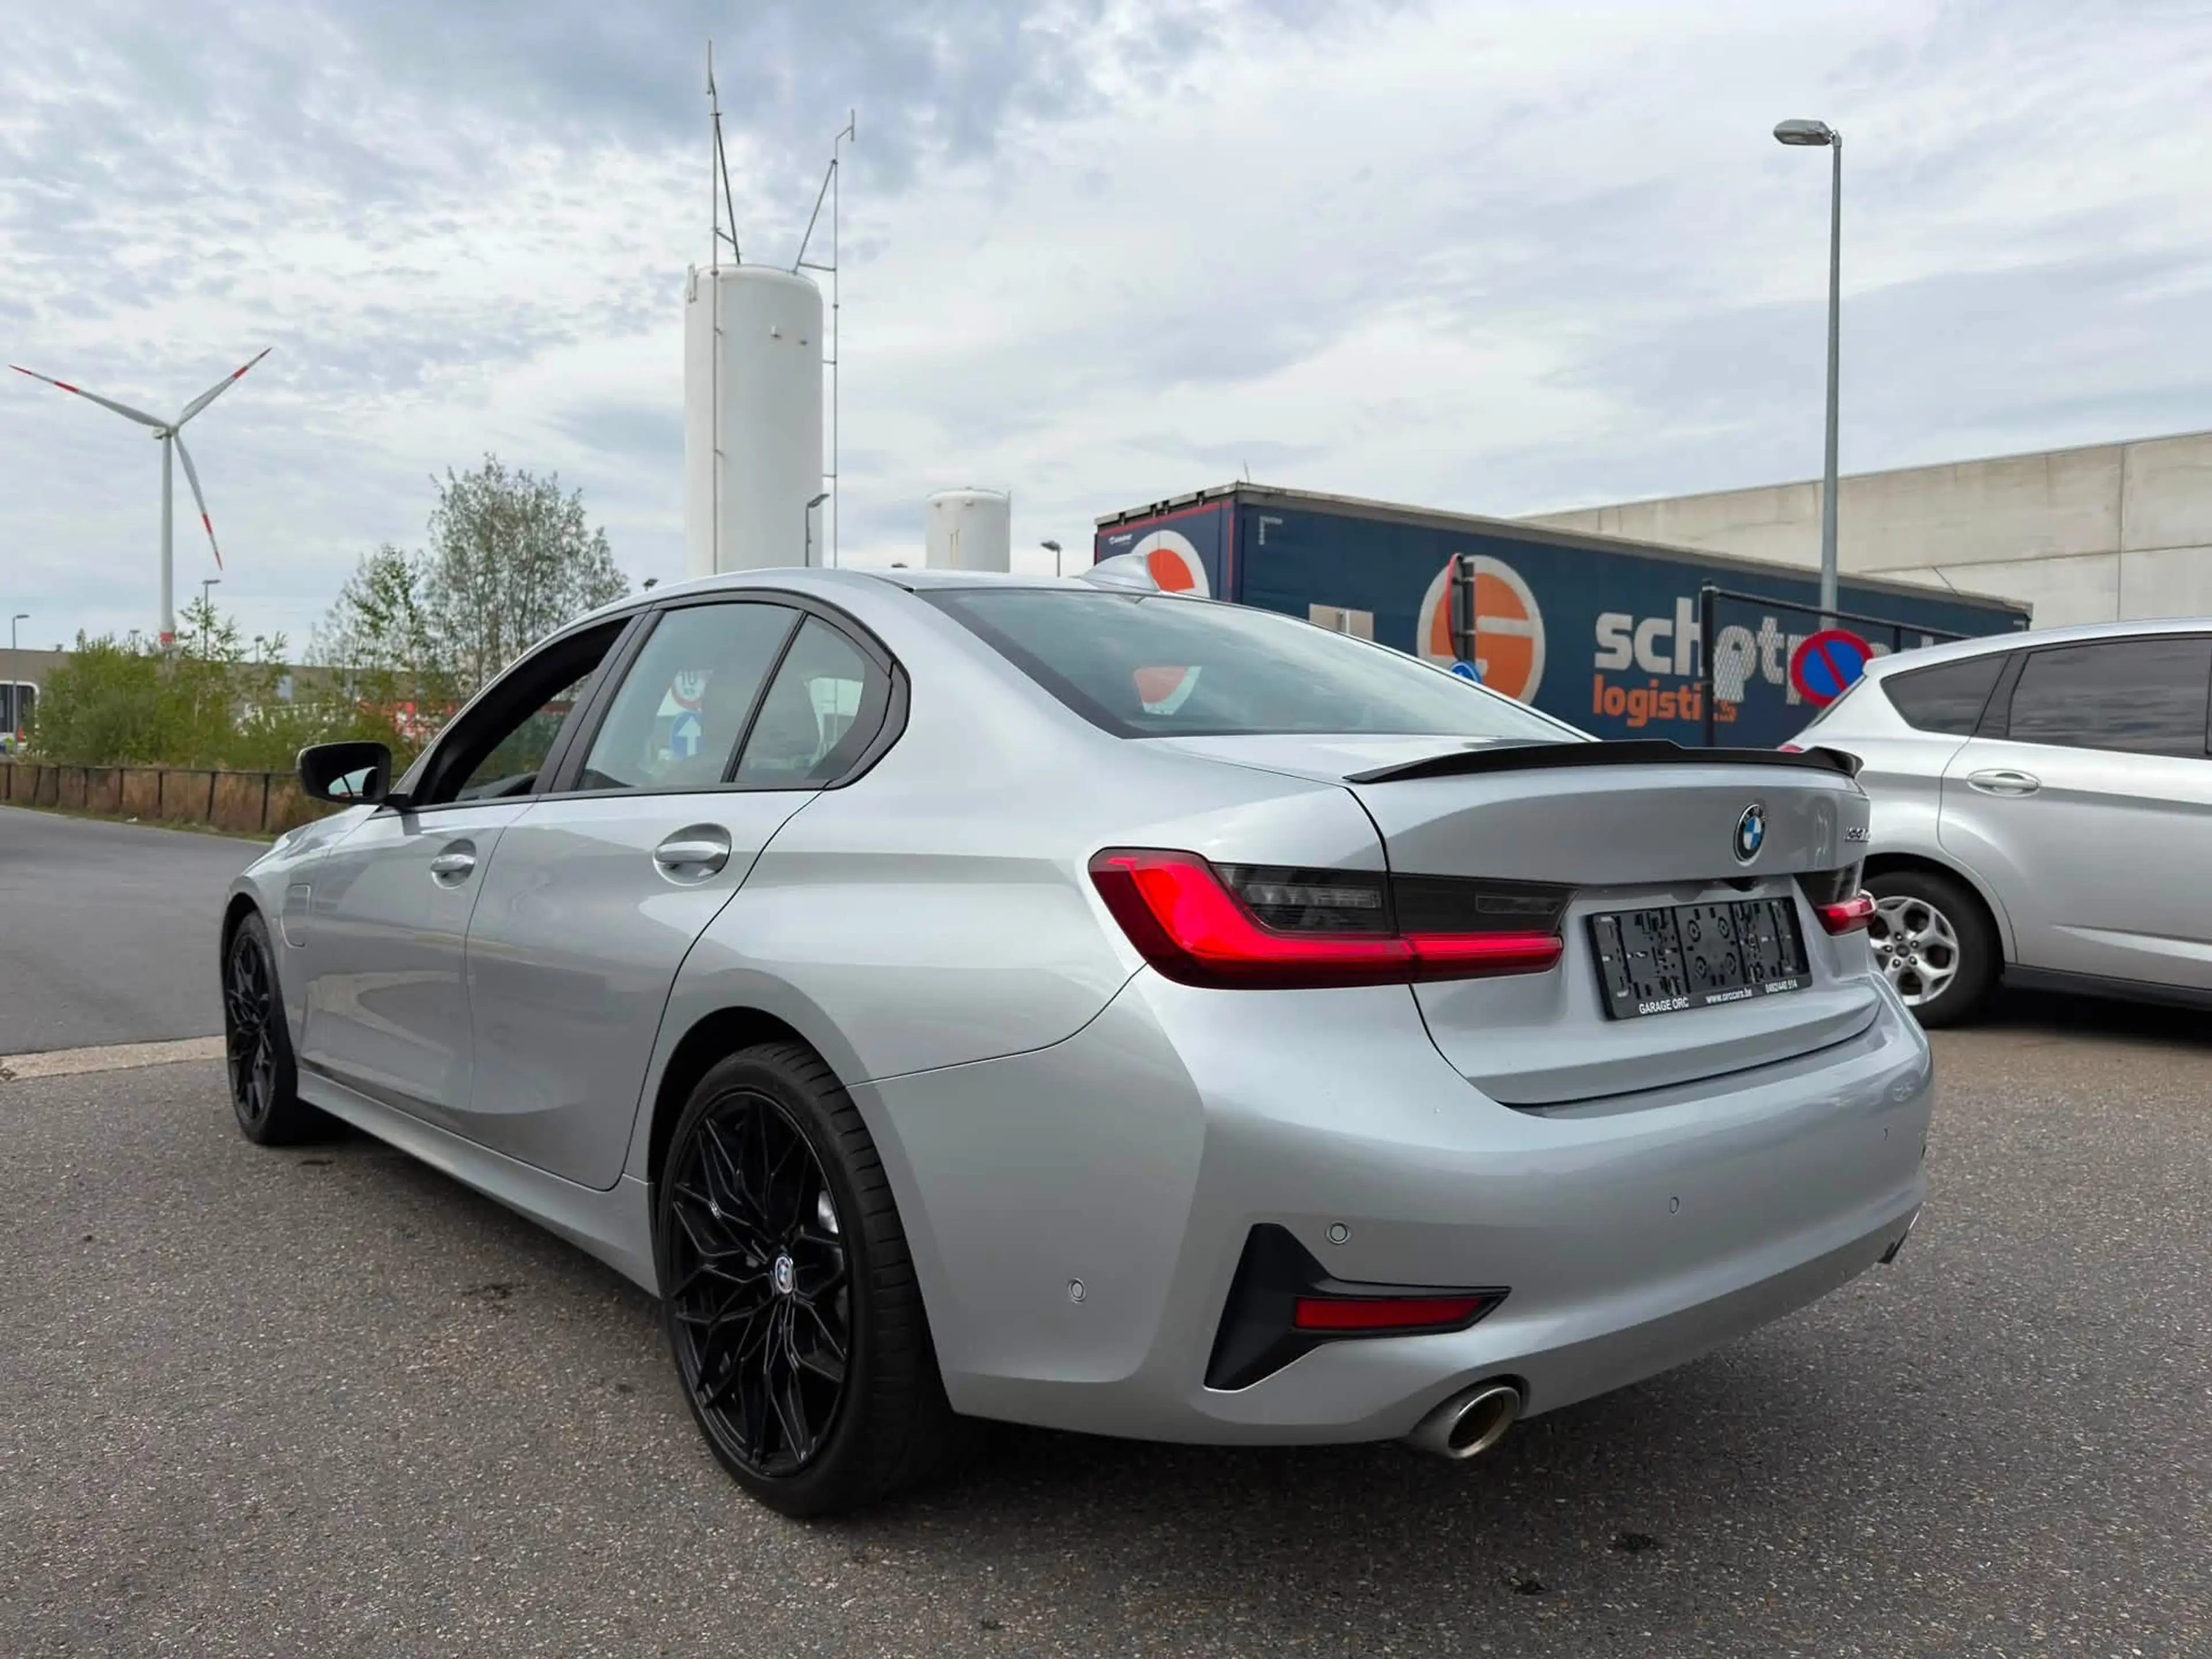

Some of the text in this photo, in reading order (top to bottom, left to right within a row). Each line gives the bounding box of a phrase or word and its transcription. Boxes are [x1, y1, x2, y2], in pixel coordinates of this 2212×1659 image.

[1593, 674, 1737, 728] logistis
[1639, 997, 1690, 1014] GARAGE ORC
